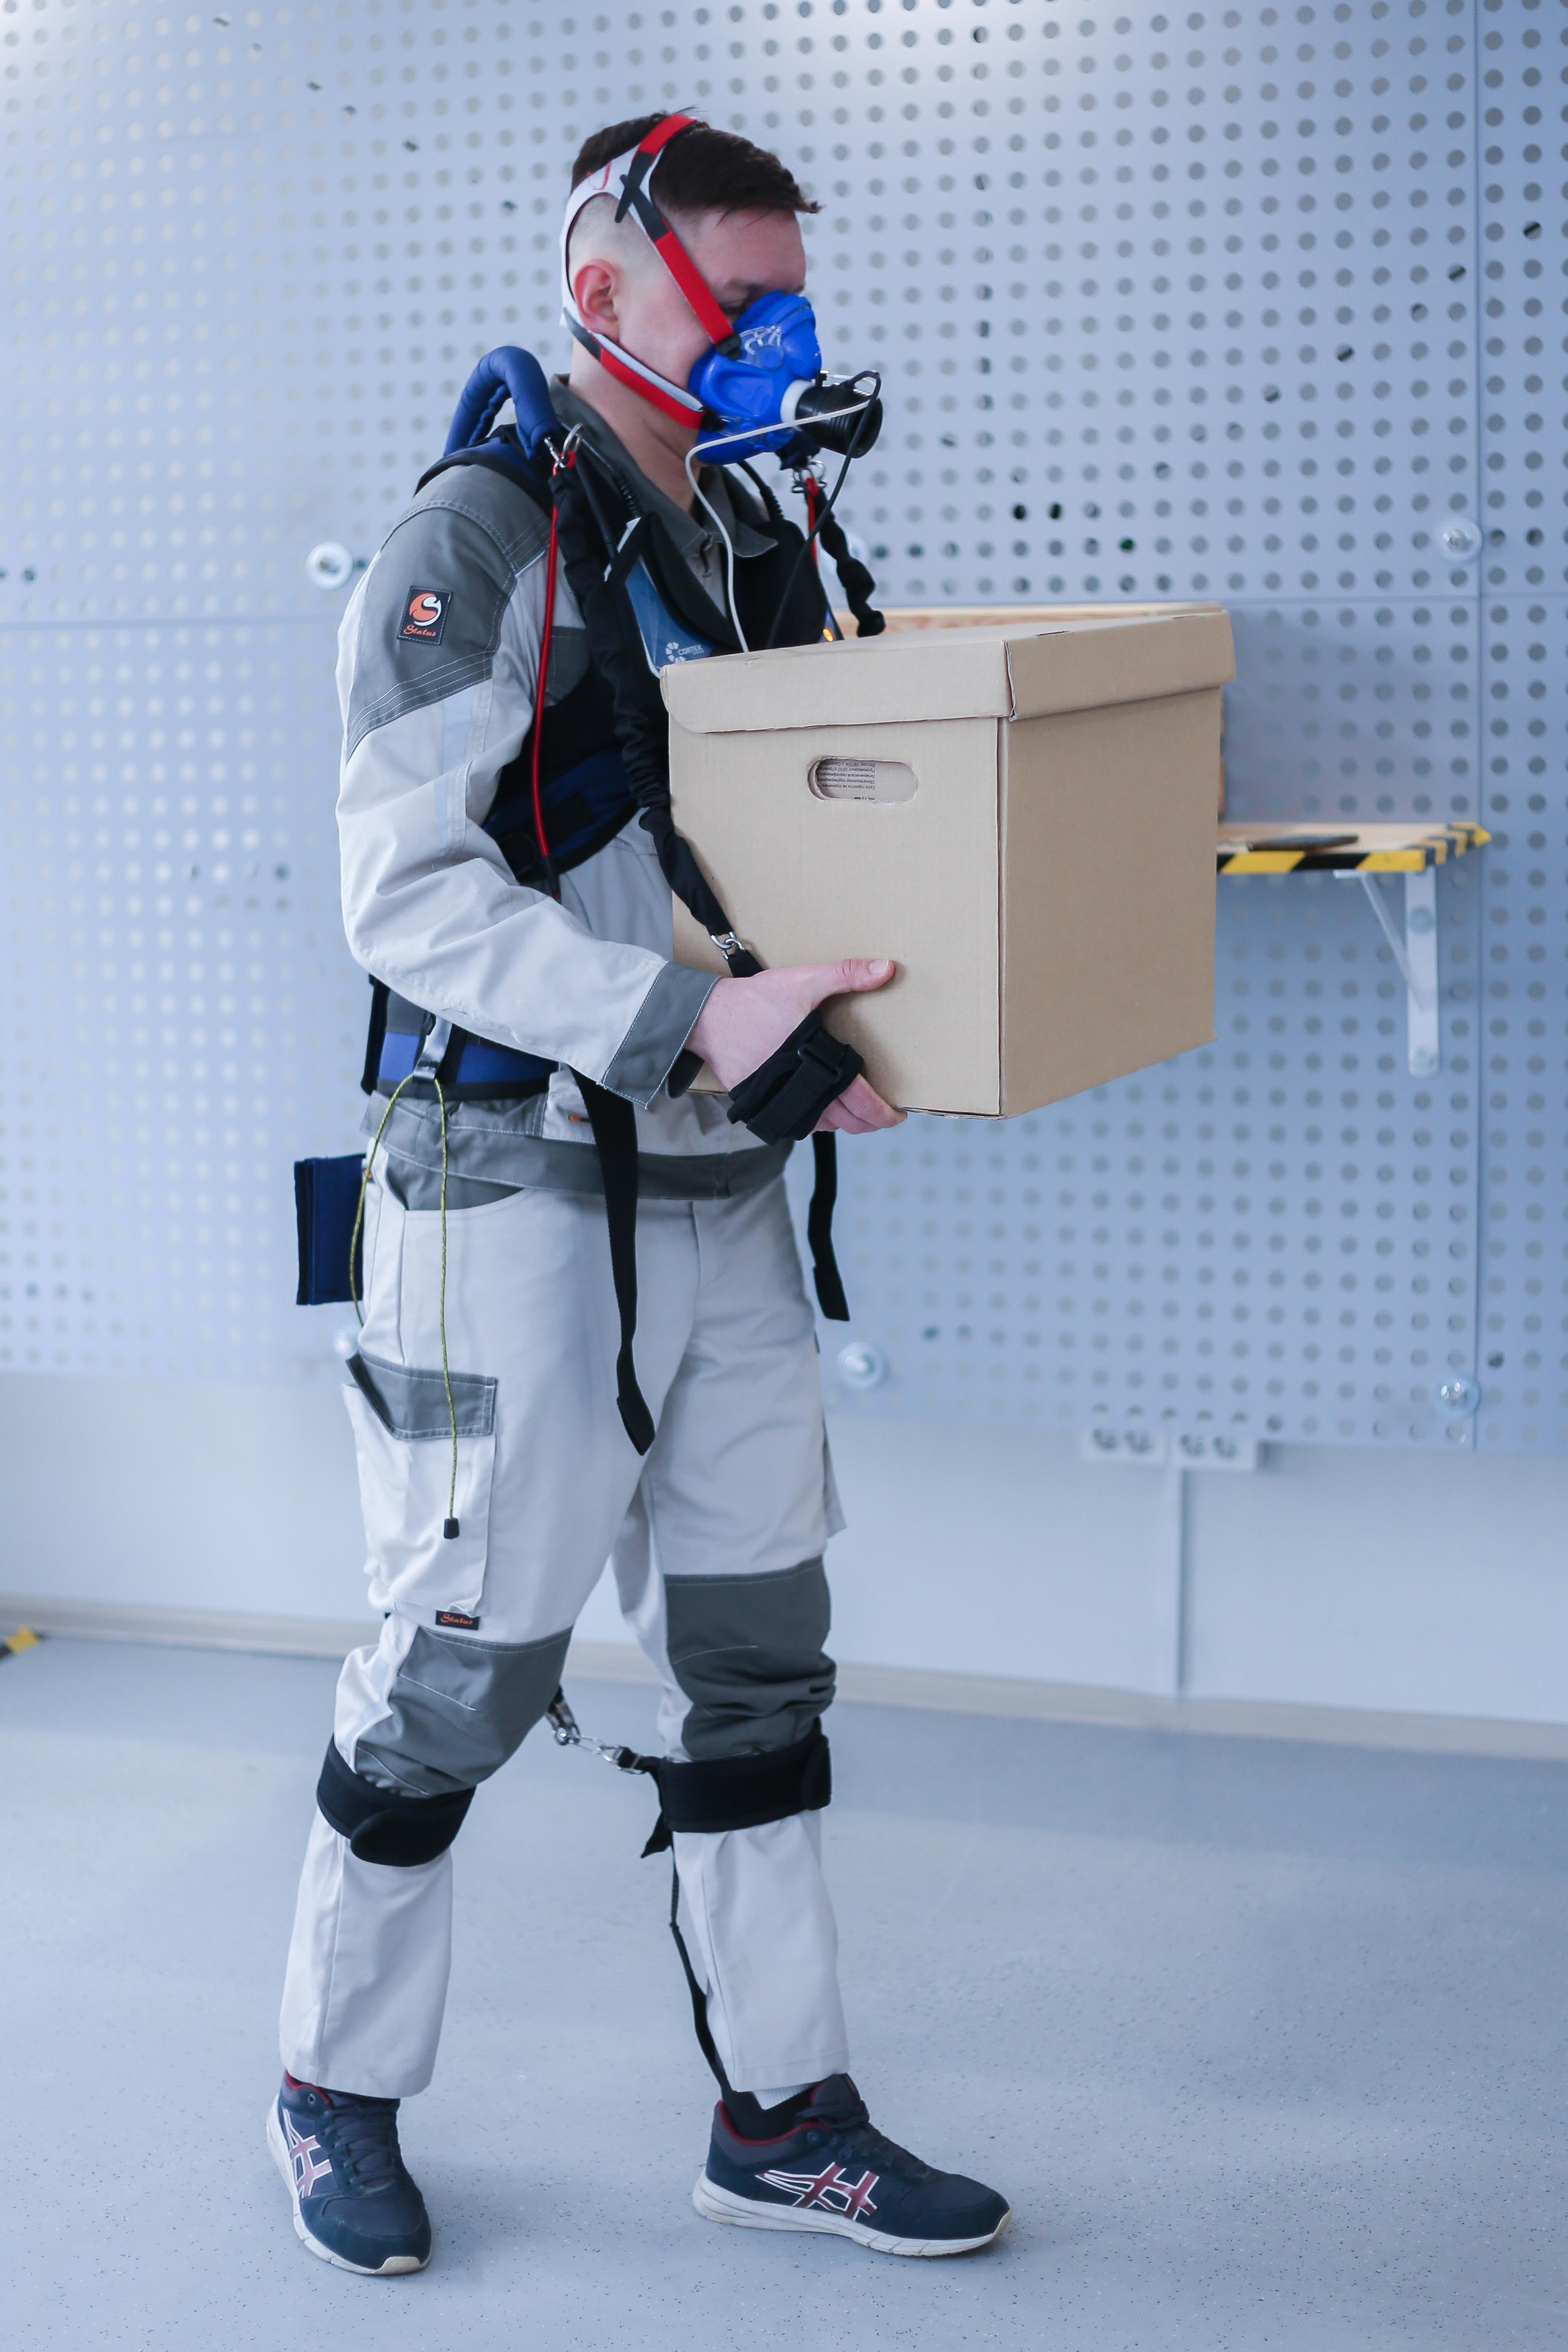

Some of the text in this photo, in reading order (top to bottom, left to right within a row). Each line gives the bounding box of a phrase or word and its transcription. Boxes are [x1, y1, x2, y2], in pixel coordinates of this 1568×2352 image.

[404, 624, 436, 637] Status
[678, 644, 704, 655] CORTEX
[441, 1613, 473, 1625] Status
